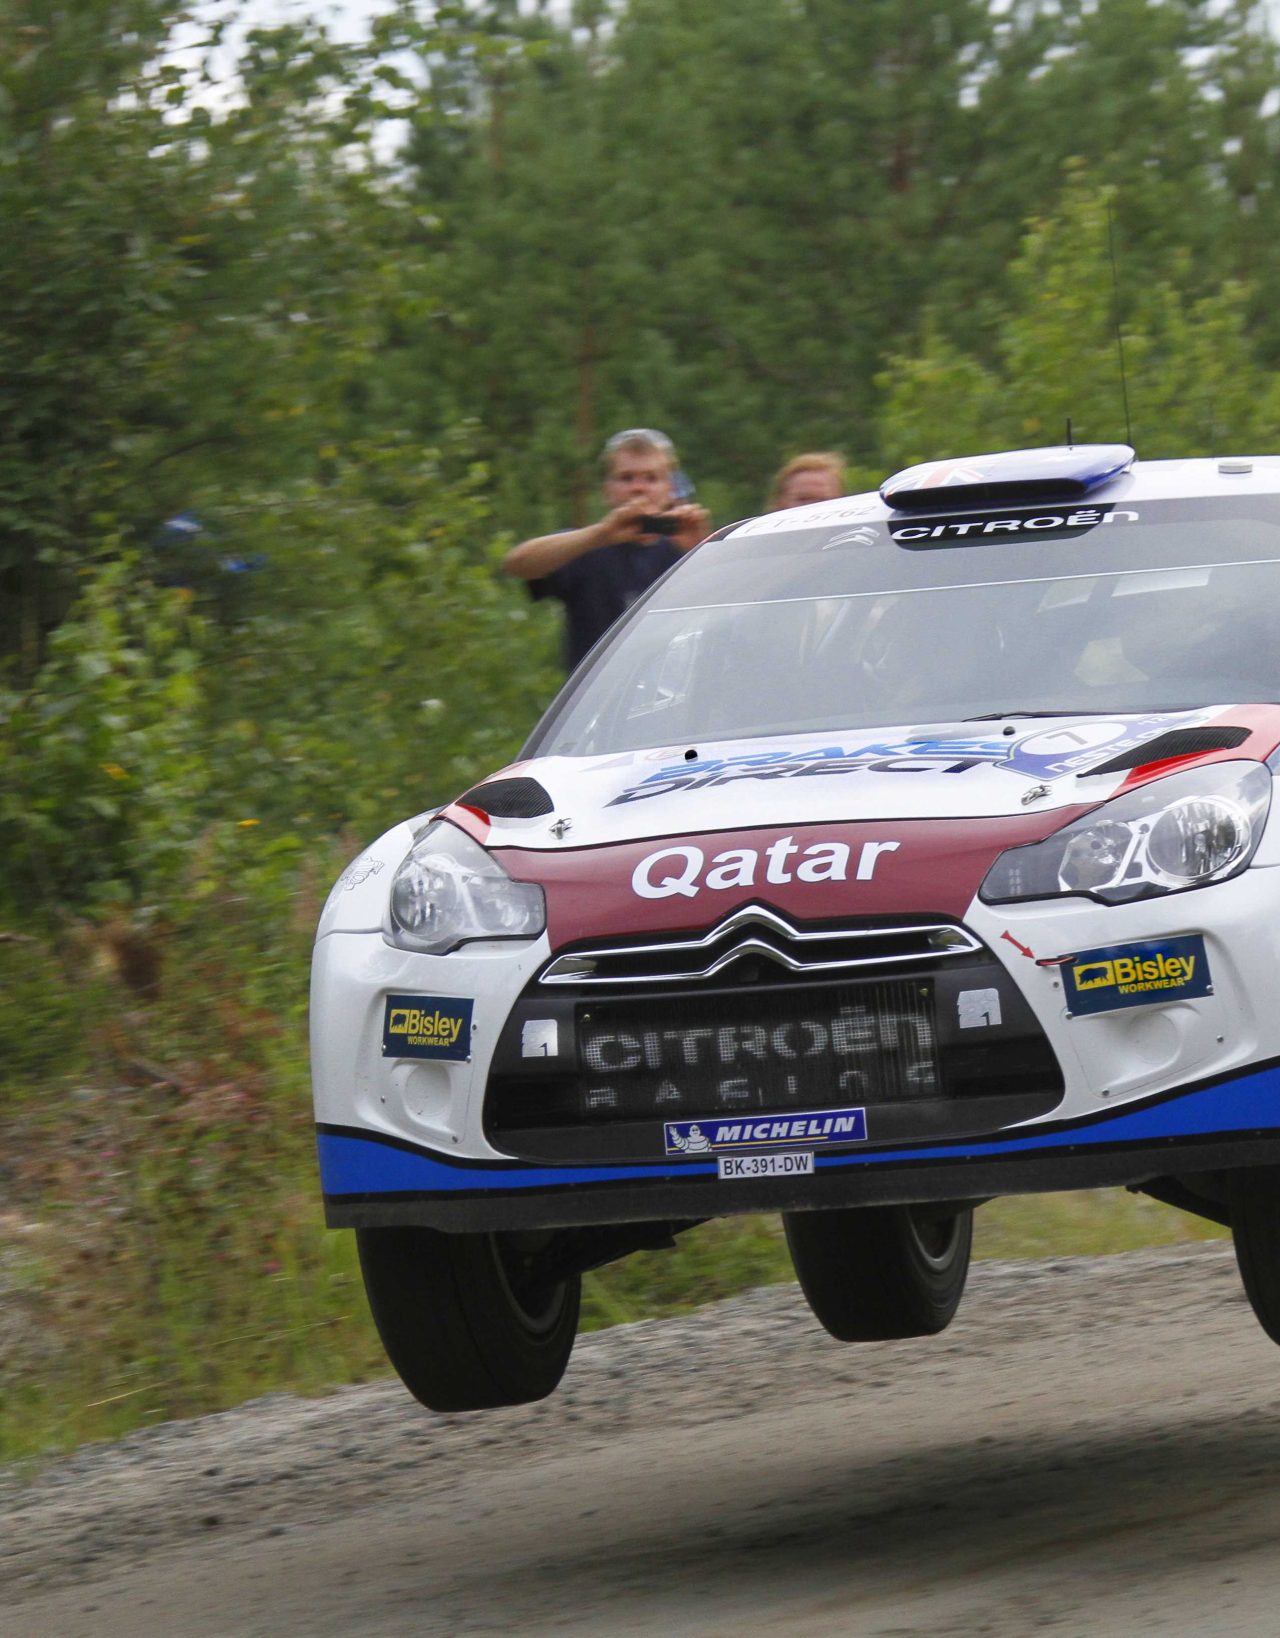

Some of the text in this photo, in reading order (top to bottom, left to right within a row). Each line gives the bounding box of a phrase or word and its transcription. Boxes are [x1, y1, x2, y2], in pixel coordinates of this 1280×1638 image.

[1046, 731, 1088, 746] 7
[1045, 738, 1142, 773] NESTE
[603, 758, 987, 808] DIRECT
[631, 835, 900, 899] Qatar
[1113, 953, 1195, 984] Bisley
[1118, 977, 1185, 994] WORKWEAR
[408, 1010, 462, 1042] Bisley
[407, 1035, 450, 1047] WORKWEAR
[715, 1116, 855, 1142] MICHELIN
[723, 1155, 809, 1176] BK-391-DW
